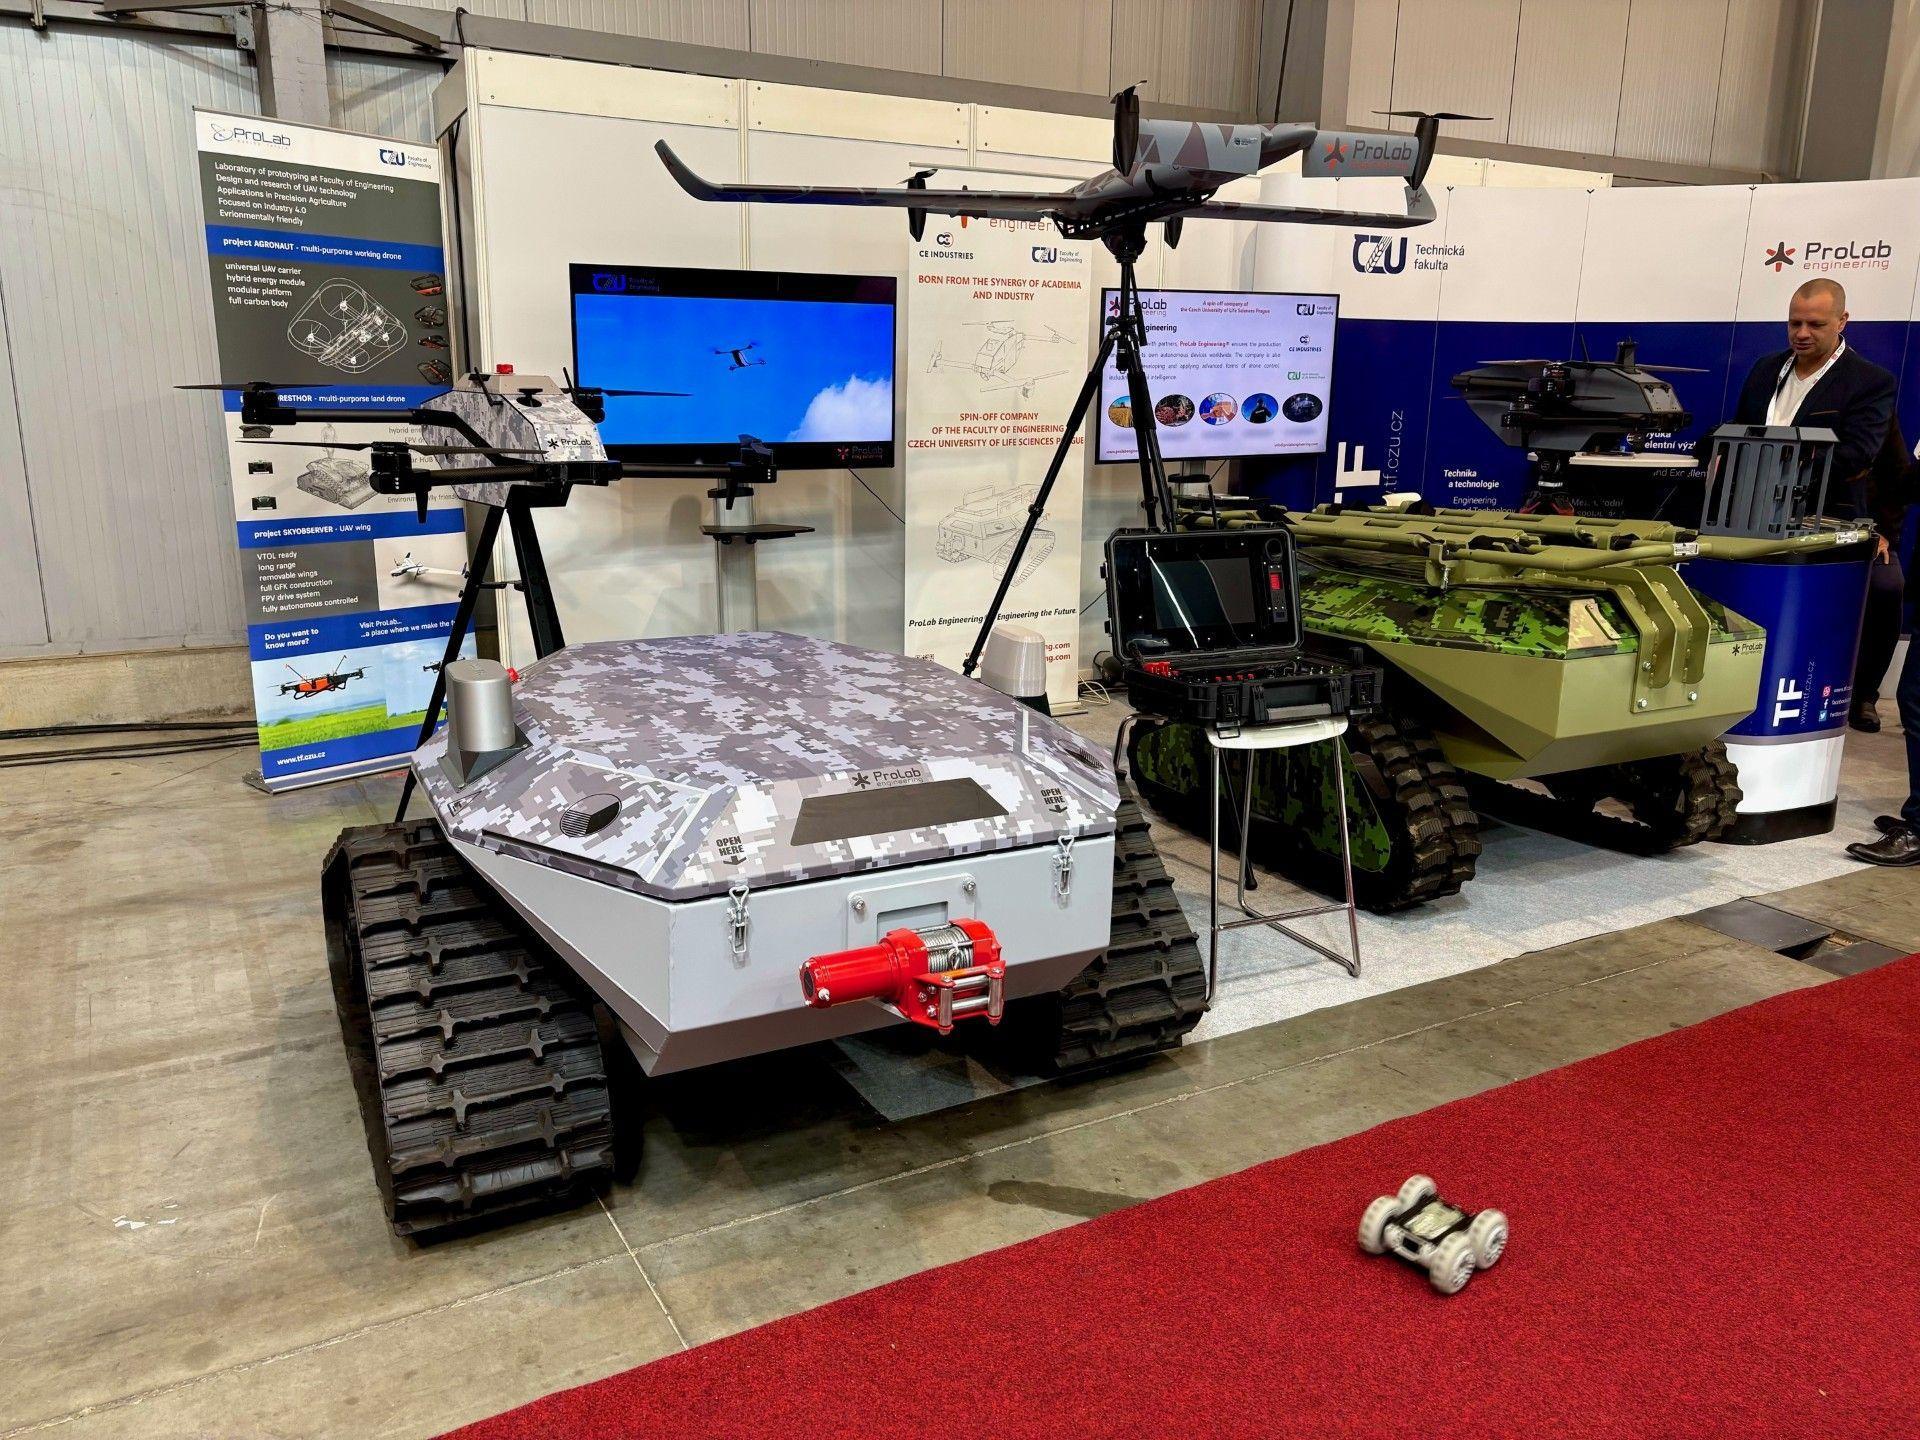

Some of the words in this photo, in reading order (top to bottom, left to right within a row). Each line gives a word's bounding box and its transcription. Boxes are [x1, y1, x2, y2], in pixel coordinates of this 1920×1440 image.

[234, 128, 290, 146] ProLab
[1353, 140, 1411, 160] ProLab
[214, 162, 256, 175] Laboratory
[267, 170, 309, 182] prototyping
[320, 176, 344, 186] Faculty
[355, 180, 394, 193] Engineering
[216, 174, 242, 184] Design
[244, 178, 259, 186] and
[261, 180, 292, 190] research
[303, 184, 317, 192] UAV
[320, 187, 357, 199] technology
[217, 186, 264, 198] Applications
[266, 191, 272, 199] in
[275, 192, 307, 203] Precision
[309, 198, 347, 208] Agriculture
[218, 198, 250, 207] Focused
[264, 203, 292, 214] Industry
[295, 206, 306, 214] 4.0
[276, 215, 303, 226] friendly
[990, 218, 1058, 232] engineeri
[223, 238, 252, 247] project
[254, 240, 294, 250] AGRONAUT
[354, 250, 380, 260] working
[382, 252, 402, 260] drone
[930, 251, 974, 259] INDUSTRIES
[1416, 244, 1465, 256] Technická
[1805, 240, 1892, 260] ProLab
[225, 263, 260, 272] universal
[278, 267, 302, 275] carrier
[1414, 259, 1449, 270] fakulta
[1803, 259, 1890, 272] engineering
[226, 274, 251, 282] hybrid
[253, 276, 277, 286] energy
[280, 278, 305, 286] module
[918, 275, 944, 284] BORN
[946, 277, 970, 285] FROM
[990, 278, 1026, 287] SYNERGY
[1041, 280, 1082, 289] ACADEMIA
[228, 286, 259, 294] modular
[262, 288, 292, 296] platform
[973, 291, 992, 299] AND
[995, 292, 1034, 300] INDUSTRY
[229, 296, 242, 304] full
[244, 298, 270, 306] carbon
[271, 299, 288, 308] body
[960, 413, 998, 421] SPIN-OFF
[963, 426, 998, 434] FACULTY
[1013, 425, 1064, 433] ENGINEERING
[908, 440, 936, 448] CZECH
[938, 439, 987, 448] UNIVERSITY
[1018, 438, 1054, 446] SCIENCES
[1056, 437, 1084, 445] PGUE
[1382, 410, 1403, 494] .tf.czu.cz
[1334, 442, 1380, 504] F
[1444, 469, 1477, 477] Technika
[1455, 480, 1499, 489] technologie
[1453, 496, 1497, 506] Engineering
[254, 530, 281, 539] project
[283, 526, 333, 536] SKYOBSERVER
[258, 564, 274, 572] long
[276, 562, 296, 570] range
[259, 571, 296, 581] removable
[298, 570, 318, 578] wings
[290, 579, 333, 589] construction
[277, 592, 294, 600] drive
[296, 591, 320, 599] system
[262, 605, 278, 613] fully
[280, 601, 322, 611] autonomous
[324, 596, 358, 606] controlled
[909, 619, 936, 627] ProLab
[997, 611, 1038, 620] Engineering
[265, 633, 275, 641] Do
[277, 632, 290, 640] you
[371, 629, 388, 637] place
[390, 625, 409, 634] where
[265, 641, 286, 650] know
[287, 638, 309, 647] more?
[1742, 642, 1762, 651] ProLab
[1801, 661, 1815, 724] www.tf.czu.cz
[1773, 678, 1802, 727] TF
[277, 752, 325, 765] www.tf.czu.cz
[873, 768, 921, 781] ProLab
[877, 778, 924, 787] engineering
[1041, 788, 1062, 797] OPEN
[1044, 795, 1065, 804] HERE
[716, 836, 741, 847] OPEN
[719, 845, 744, 856] HERE
